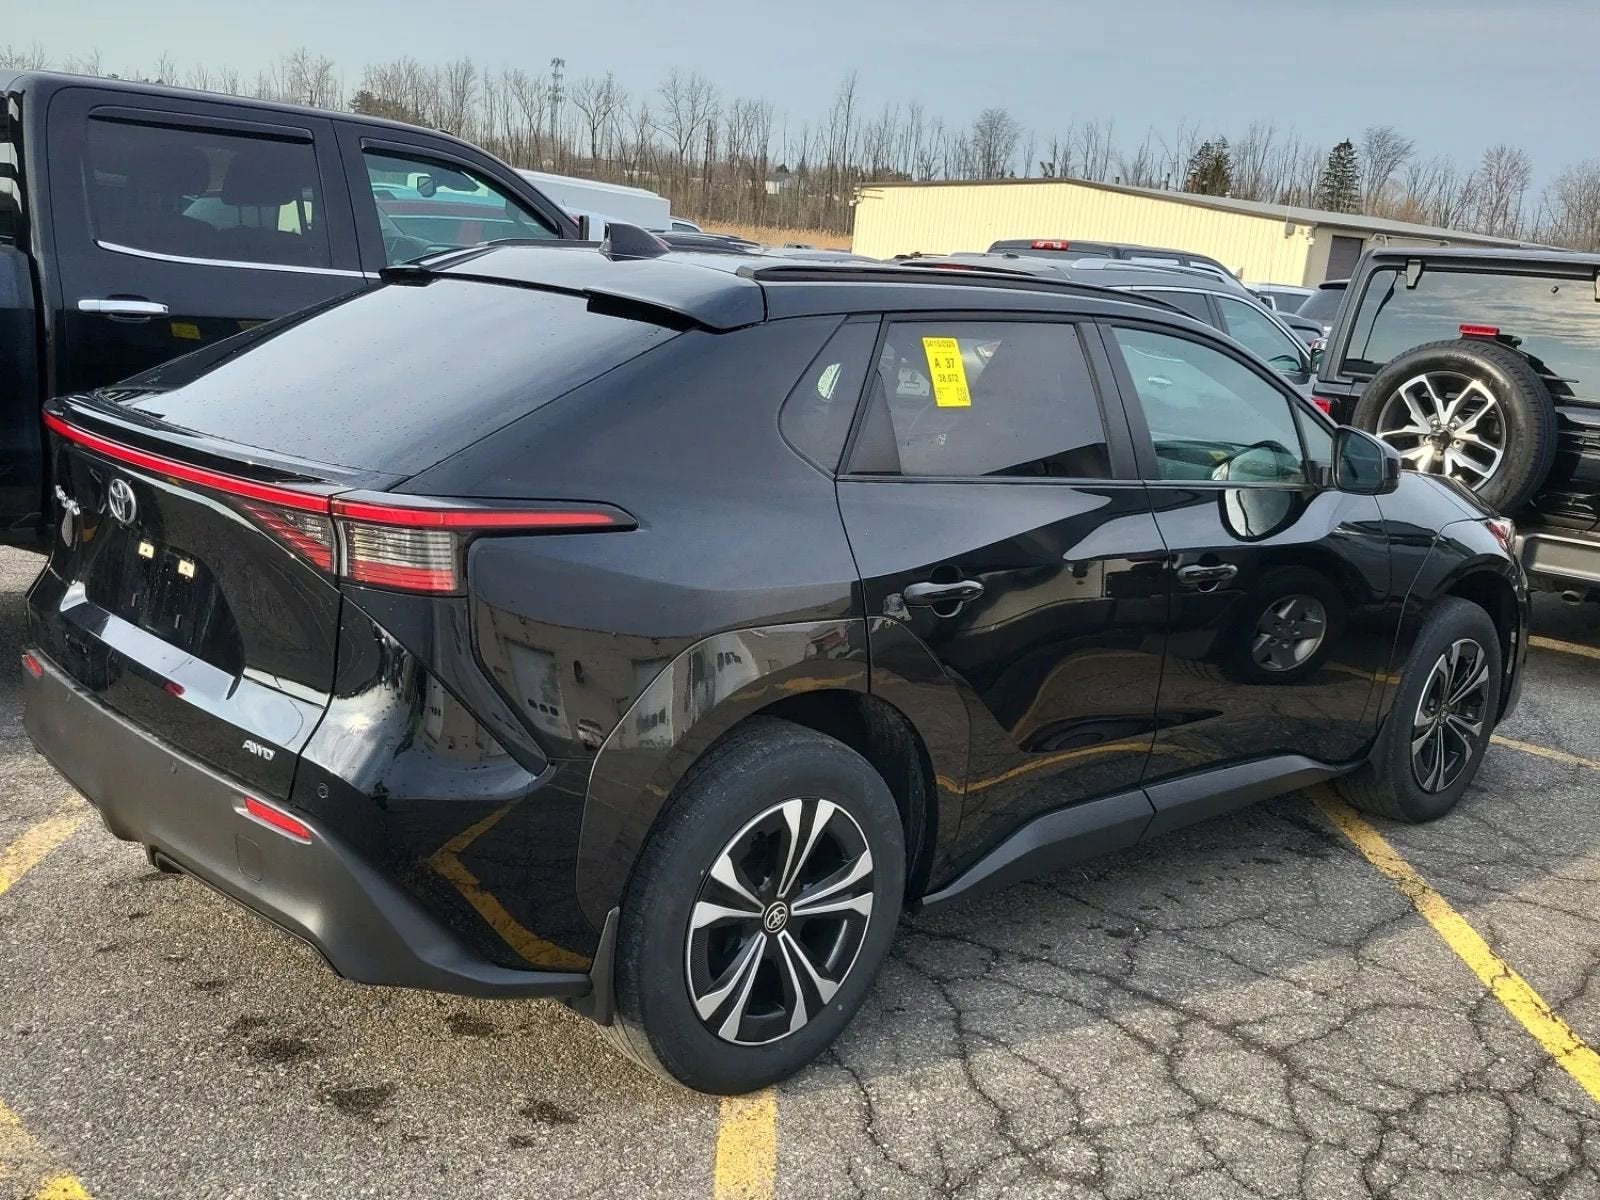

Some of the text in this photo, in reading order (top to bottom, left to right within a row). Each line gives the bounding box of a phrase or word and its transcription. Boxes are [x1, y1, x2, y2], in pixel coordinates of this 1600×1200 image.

[934, 357, 955, 369] A 37
[242, 739, 276, 761] AWD
